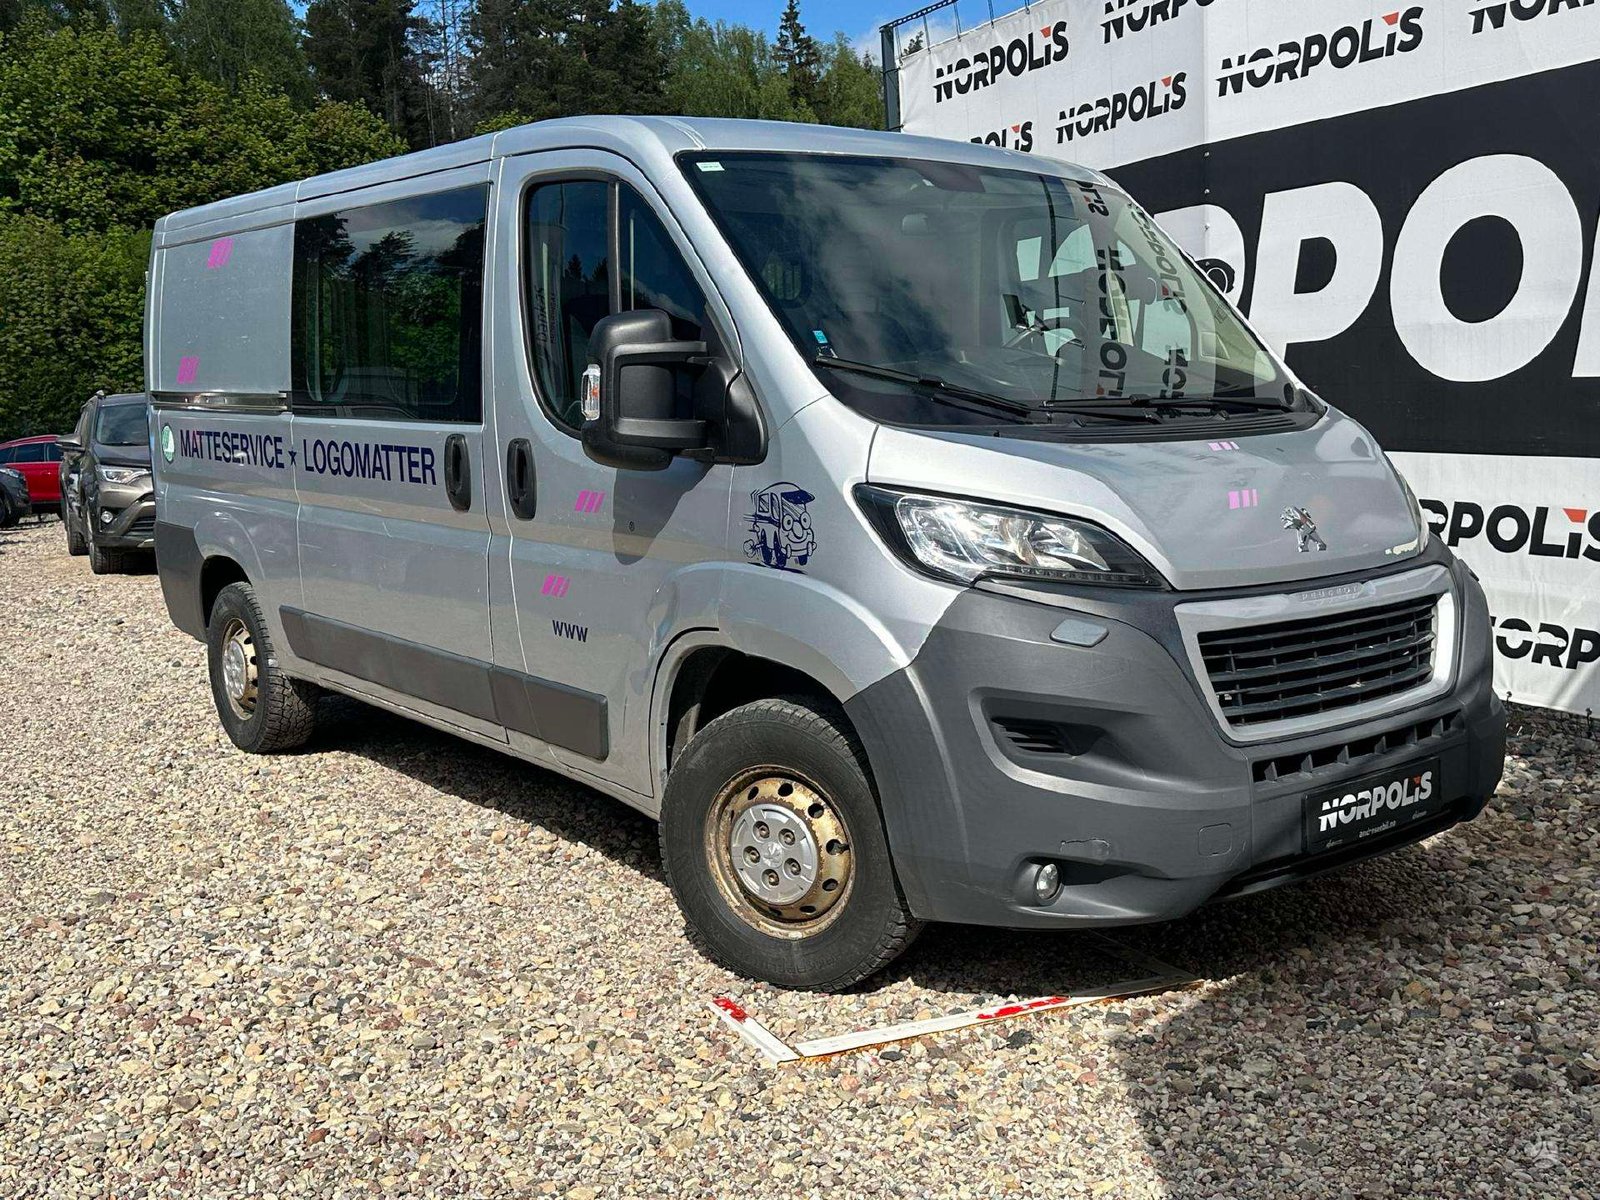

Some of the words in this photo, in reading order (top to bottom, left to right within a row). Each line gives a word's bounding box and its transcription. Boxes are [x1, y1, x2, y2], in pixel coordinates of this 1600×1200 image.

[180, 429, 285, 469] MATTESERVICE
[303, 438, 436, 486] LOGOMATTER
[1489, 615, 1600, 670] ORP
